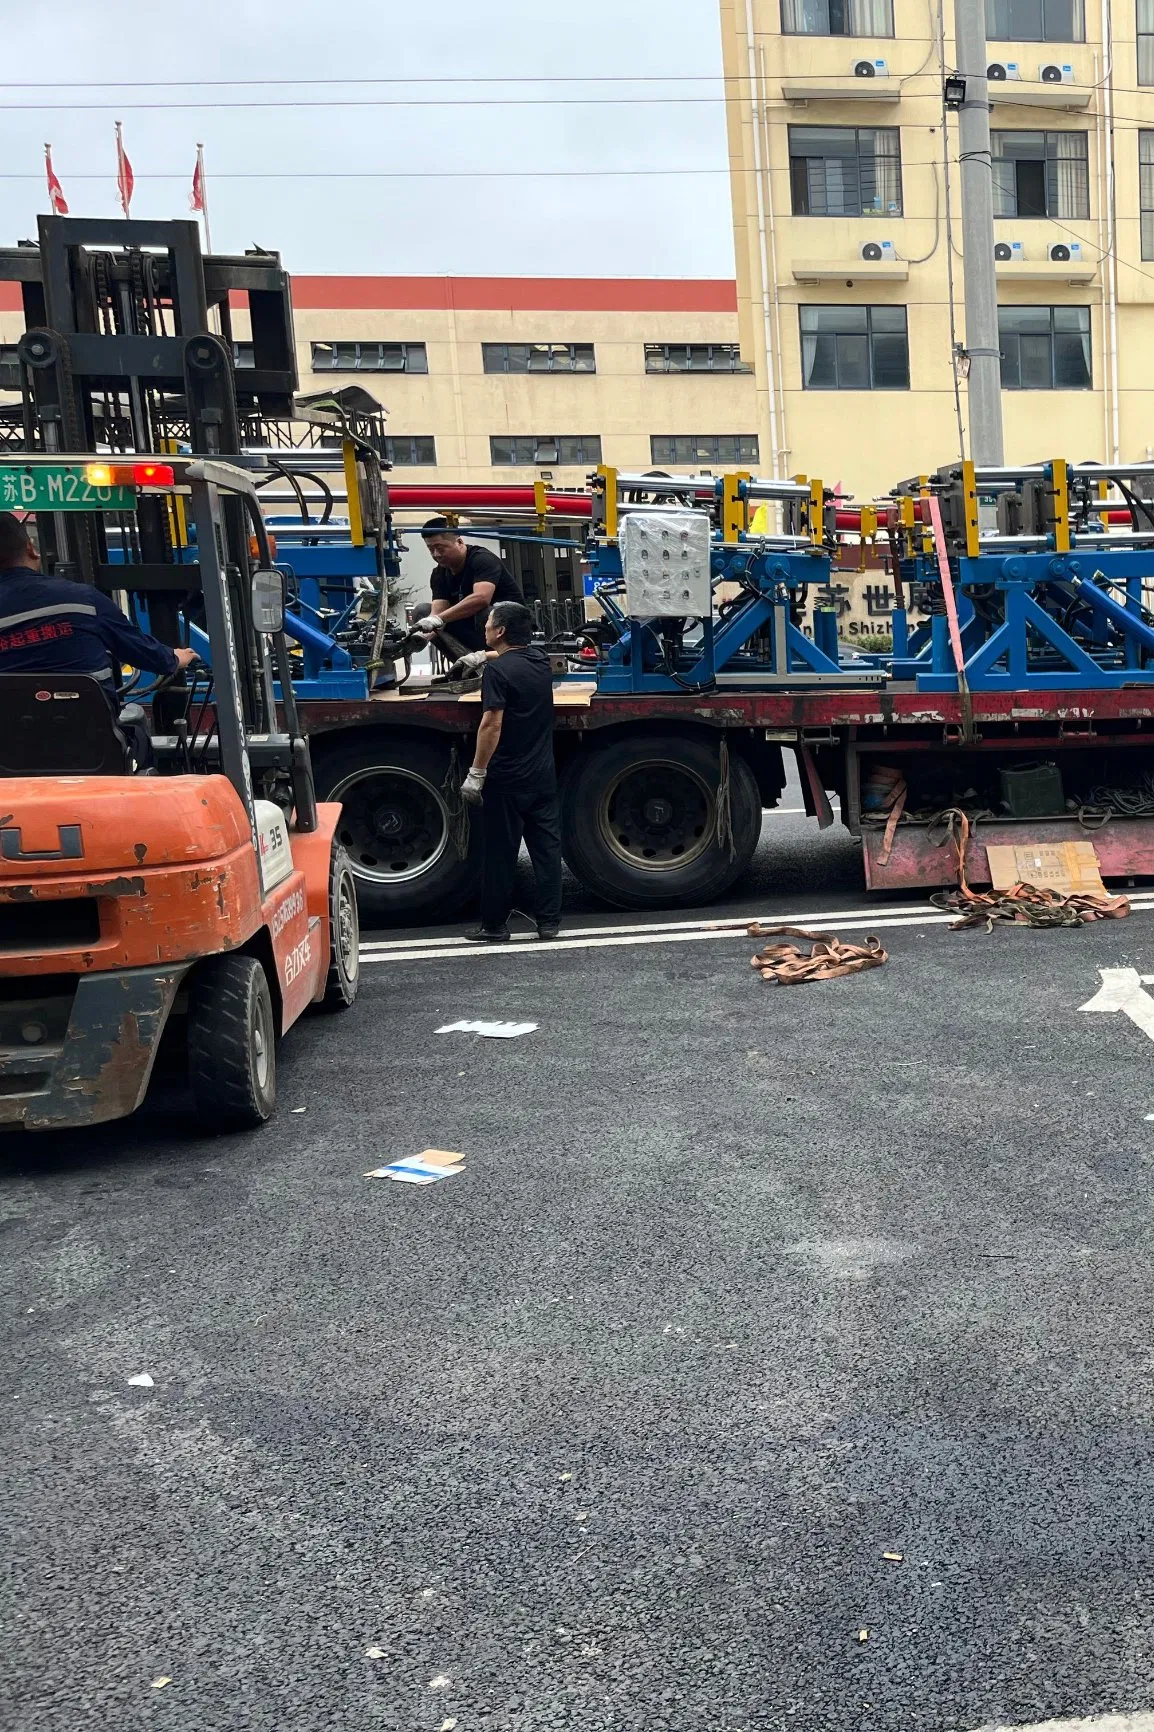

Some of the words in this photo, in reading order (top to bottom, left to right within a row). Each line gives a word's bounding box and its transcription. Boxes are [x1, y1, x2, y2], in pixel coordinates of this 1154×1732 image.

[269, 825, 283, 851] 35
[284, 934, 312, 987] 合力叉车
